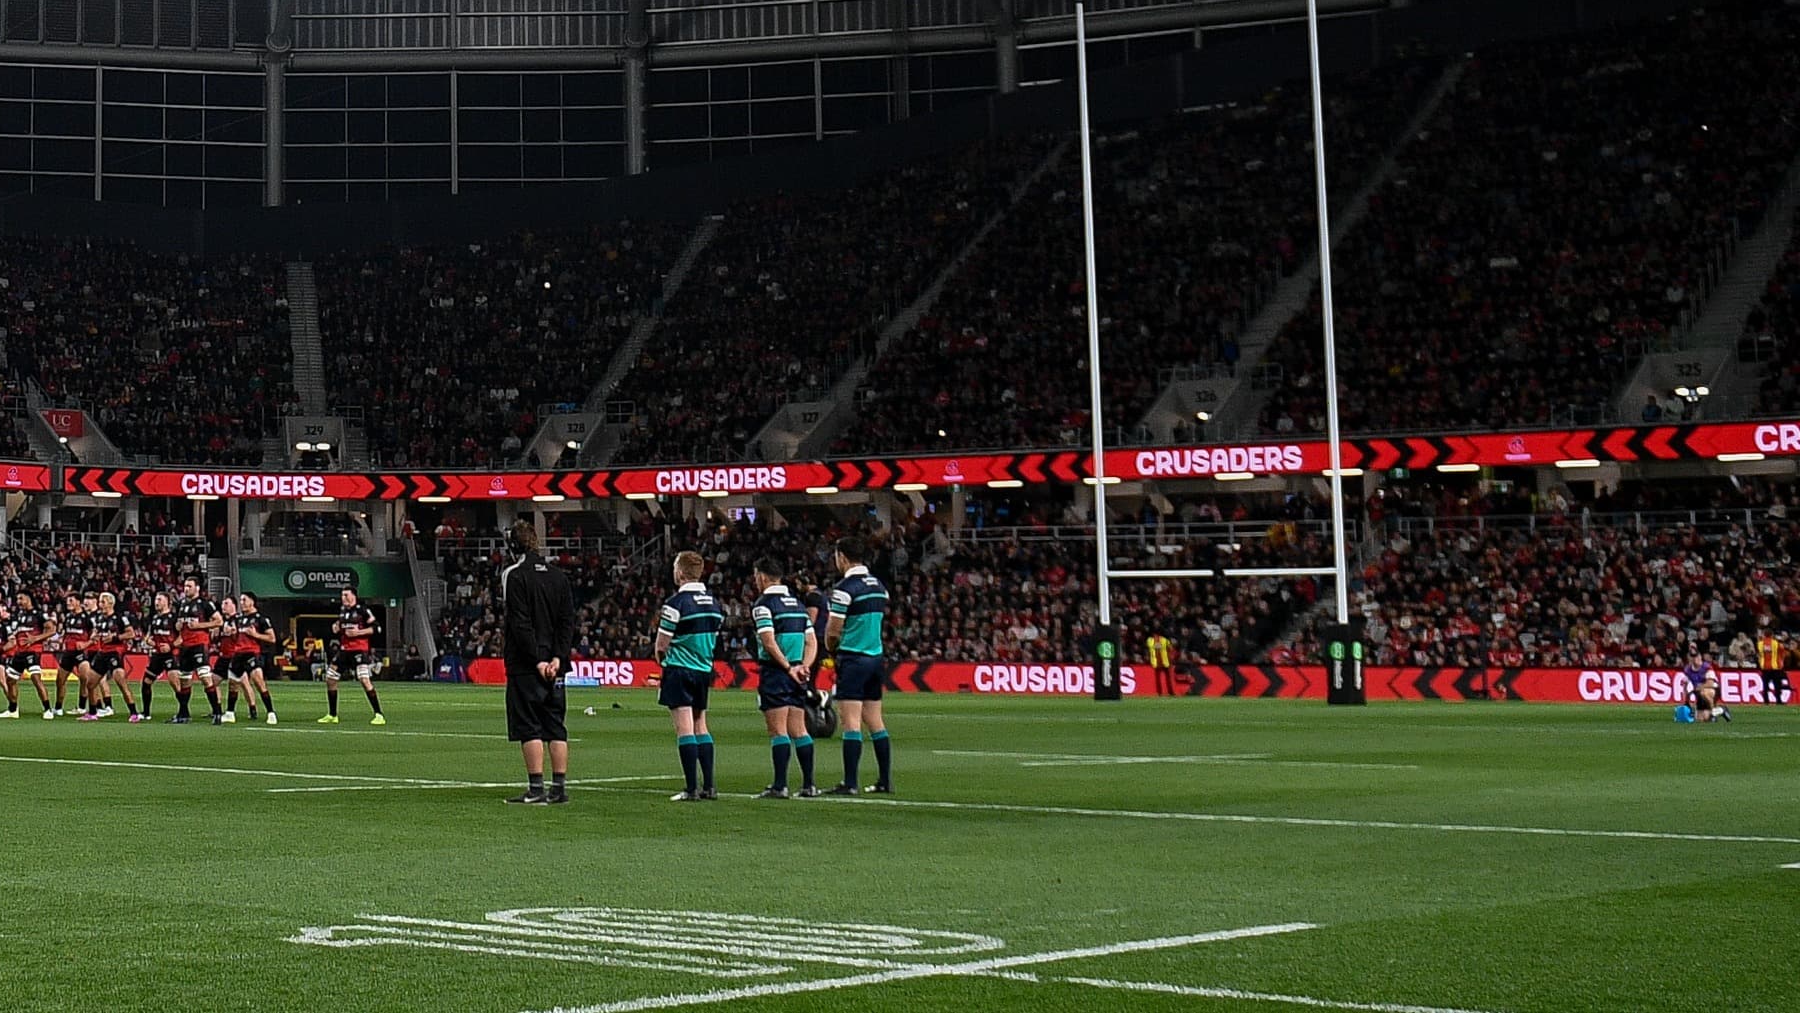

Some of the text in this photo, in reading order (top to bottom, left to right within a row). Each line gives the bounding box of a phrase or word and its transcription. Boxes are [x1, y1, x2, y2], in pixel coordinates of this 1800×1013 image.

[52, 414, 71, 427] UC
[1137, 445, 1303, 476] CRUSADERS
[181, 473, 325, 497] CRUSADERS
[656, 466, 786, 493] CRUSADERS
[308, 572, 350, 582] one.nz
[974, 665, 1137, 694] CRUSADES
